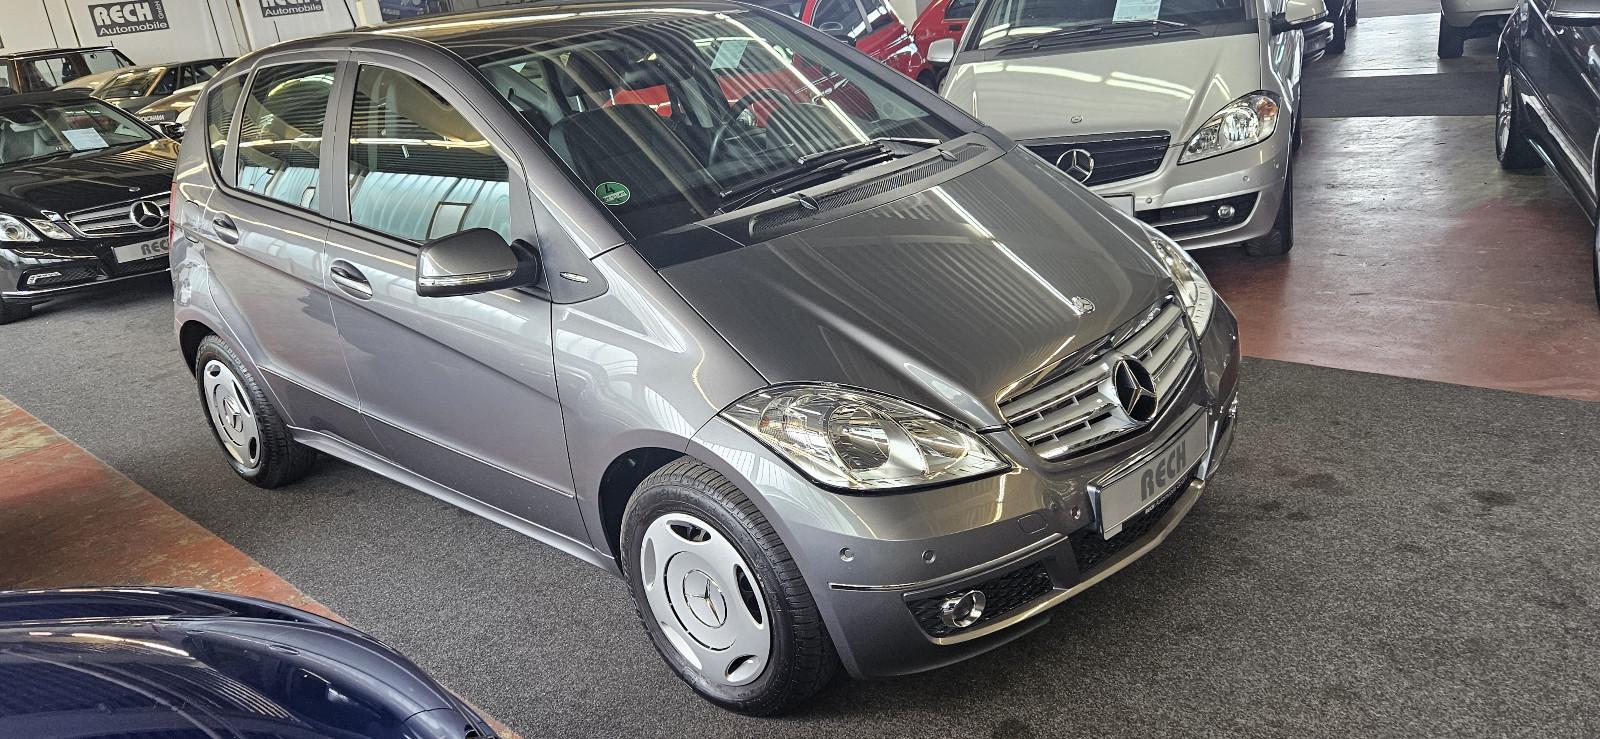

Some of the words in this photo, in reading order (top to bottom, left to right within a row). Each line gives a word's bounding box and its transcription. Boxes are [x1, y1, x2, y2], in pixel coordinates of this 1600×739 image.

[93, 2, 153, 26] RECH
[264, 3, 322, 16] Automobile
[99, 21, 168, 36] Automobile
[140, 239, 169, 256] REC
[1141, 439, 1186, 502] RECH
